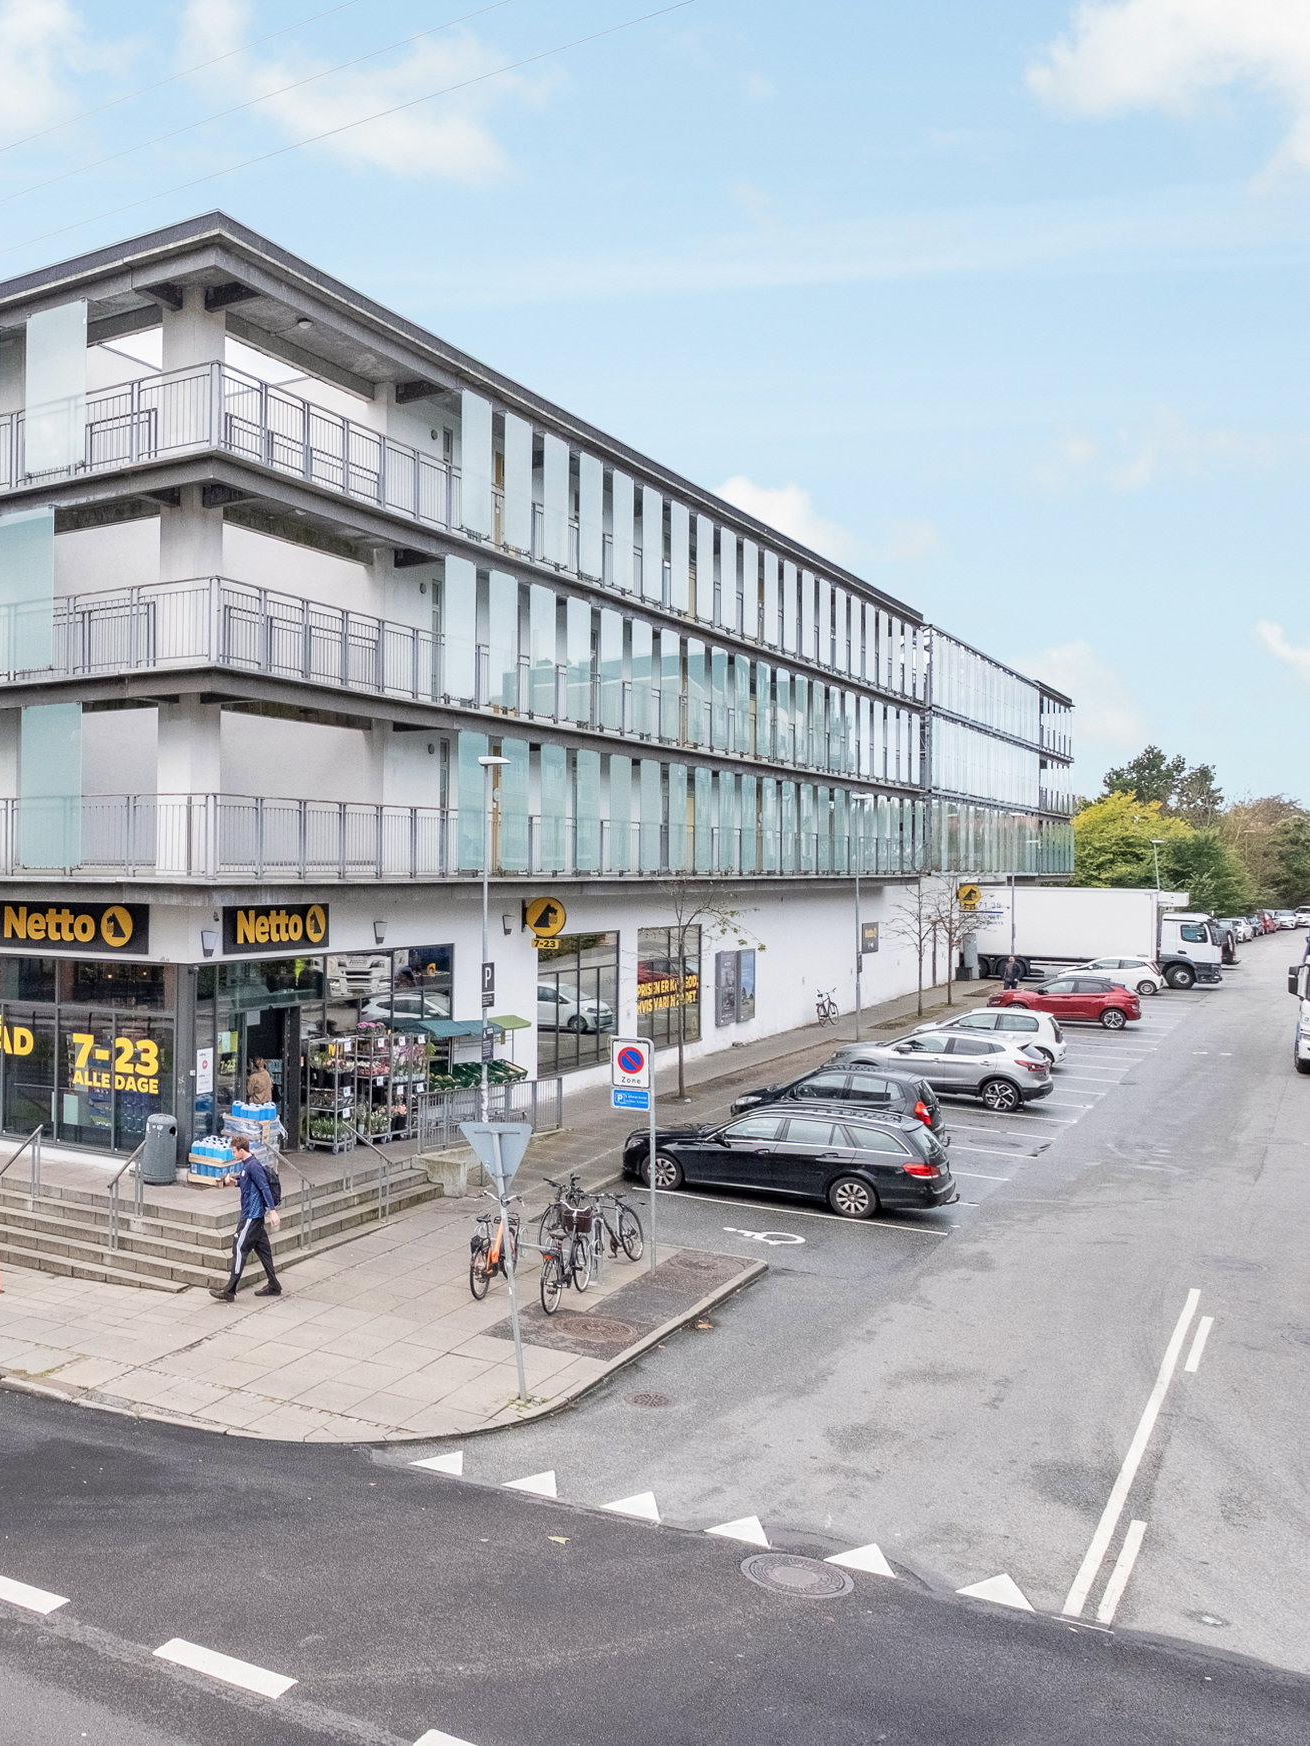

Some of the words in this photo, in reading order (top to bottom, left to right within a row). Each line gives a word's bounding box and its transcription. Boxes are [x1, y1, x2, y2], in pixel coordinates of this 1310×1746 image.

[3, 905, 95, 943] Netto
[236, 909, 302, 945] Netto
[534, 939, 556, 948] 7-23
[484, 966, 492, 989] P
[72, 1032, 159, 1076] 7-23
[72, 1070, 110, 1088] ALLE
[114, 1074, 159, 1095] DAGE
[621, 1076, 641, 1084] Zone
